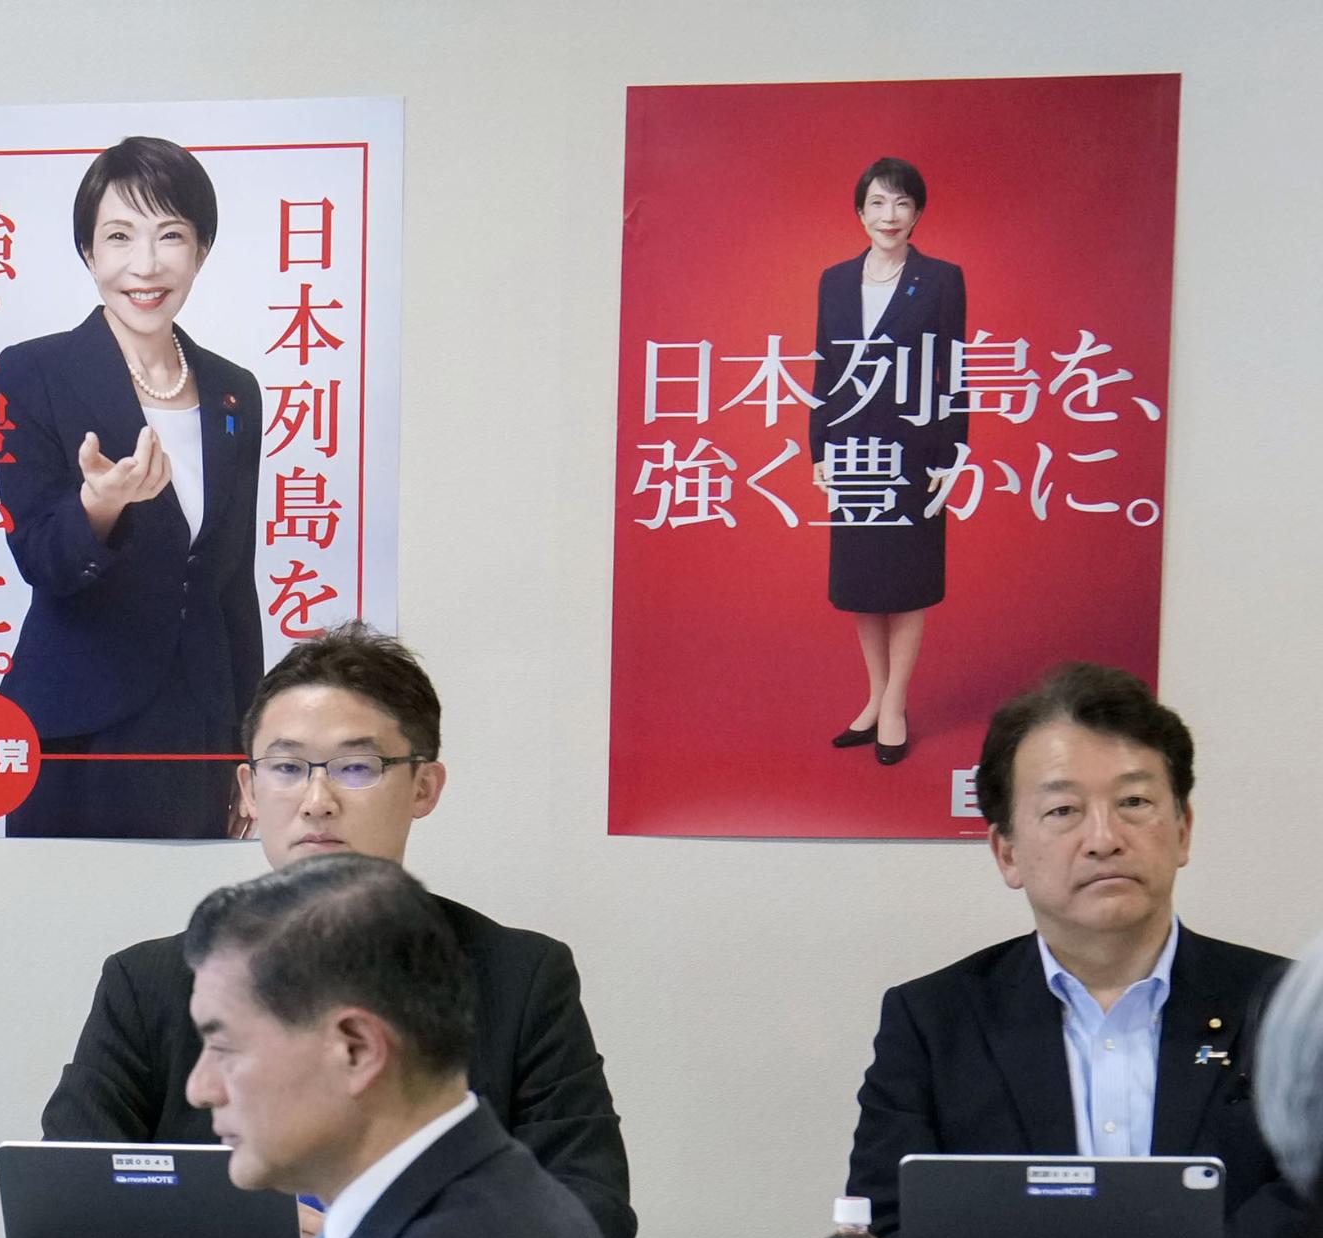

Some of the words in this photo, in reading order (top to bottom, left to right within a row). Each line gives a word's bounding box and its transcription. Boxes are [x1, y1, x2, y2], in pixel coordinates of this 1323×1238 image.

[642, 329, 1161, 428] 日本列島を、
[632, 436, 1160, 531] 強く豊かに。
